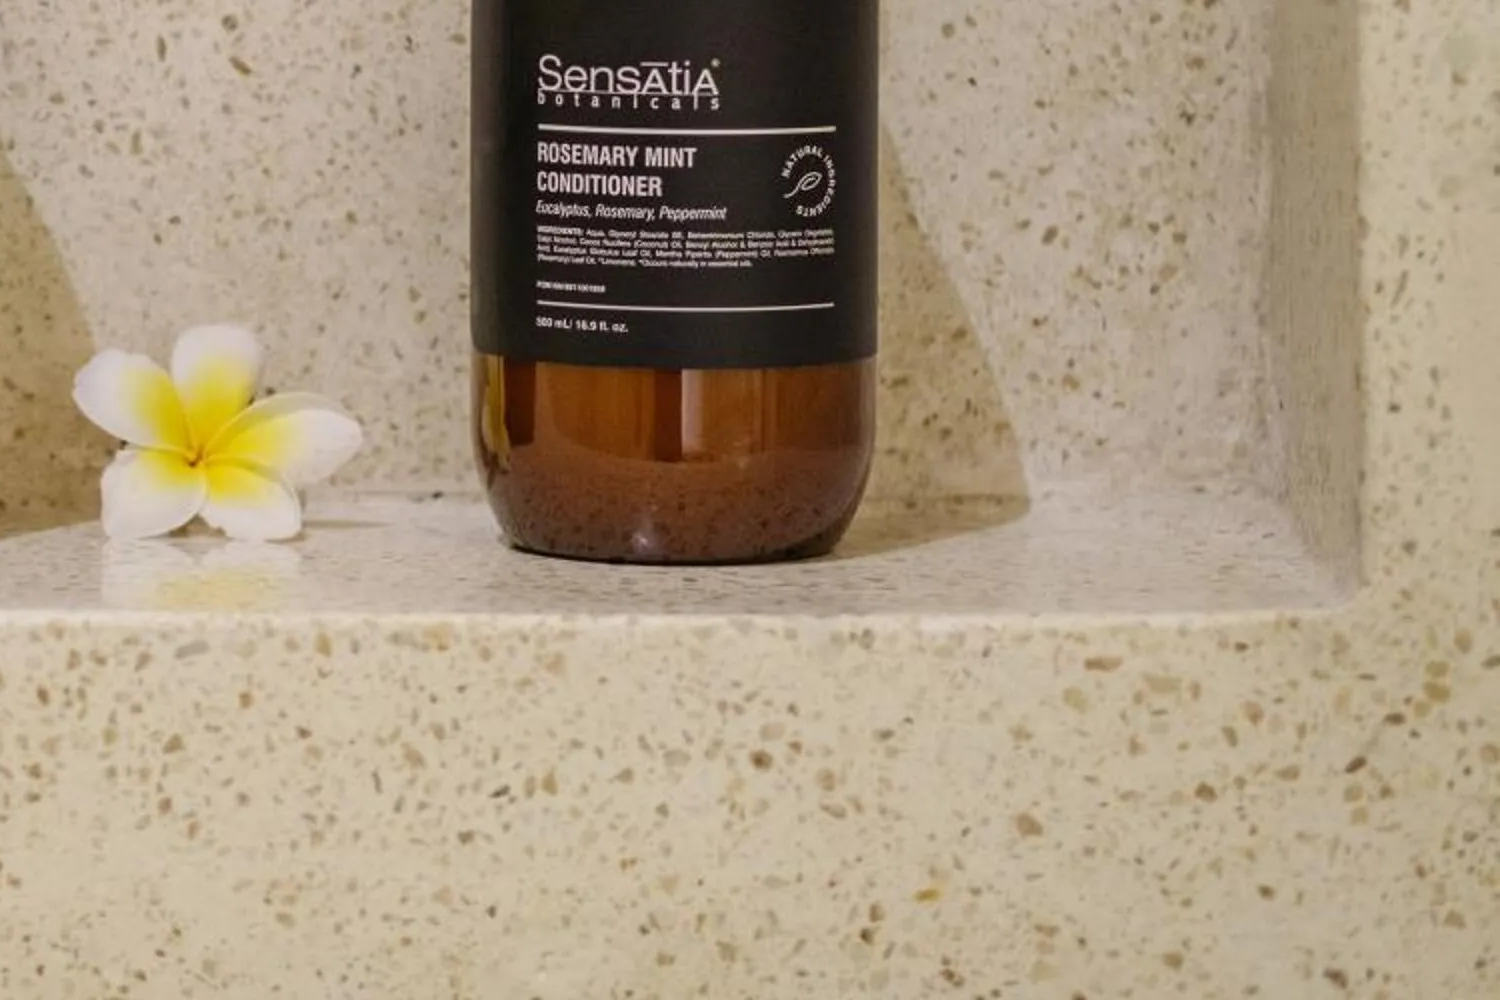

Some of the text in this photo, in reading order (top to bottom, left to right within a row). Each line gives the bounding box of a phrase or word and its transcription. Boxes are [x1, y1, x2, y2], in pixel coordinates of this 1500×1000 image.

[538, 89, 719, 110] botanicals
[538, 142, 697, 168] ROSEMARY MINT
[538, 172, 662, 197] CONDITIONER
[781, 145, 836, 217] NATURAL INGREDIENTS
[596, 204, 655, 221] Rosemary,
[659, 206, 727, 221] Peppermint
